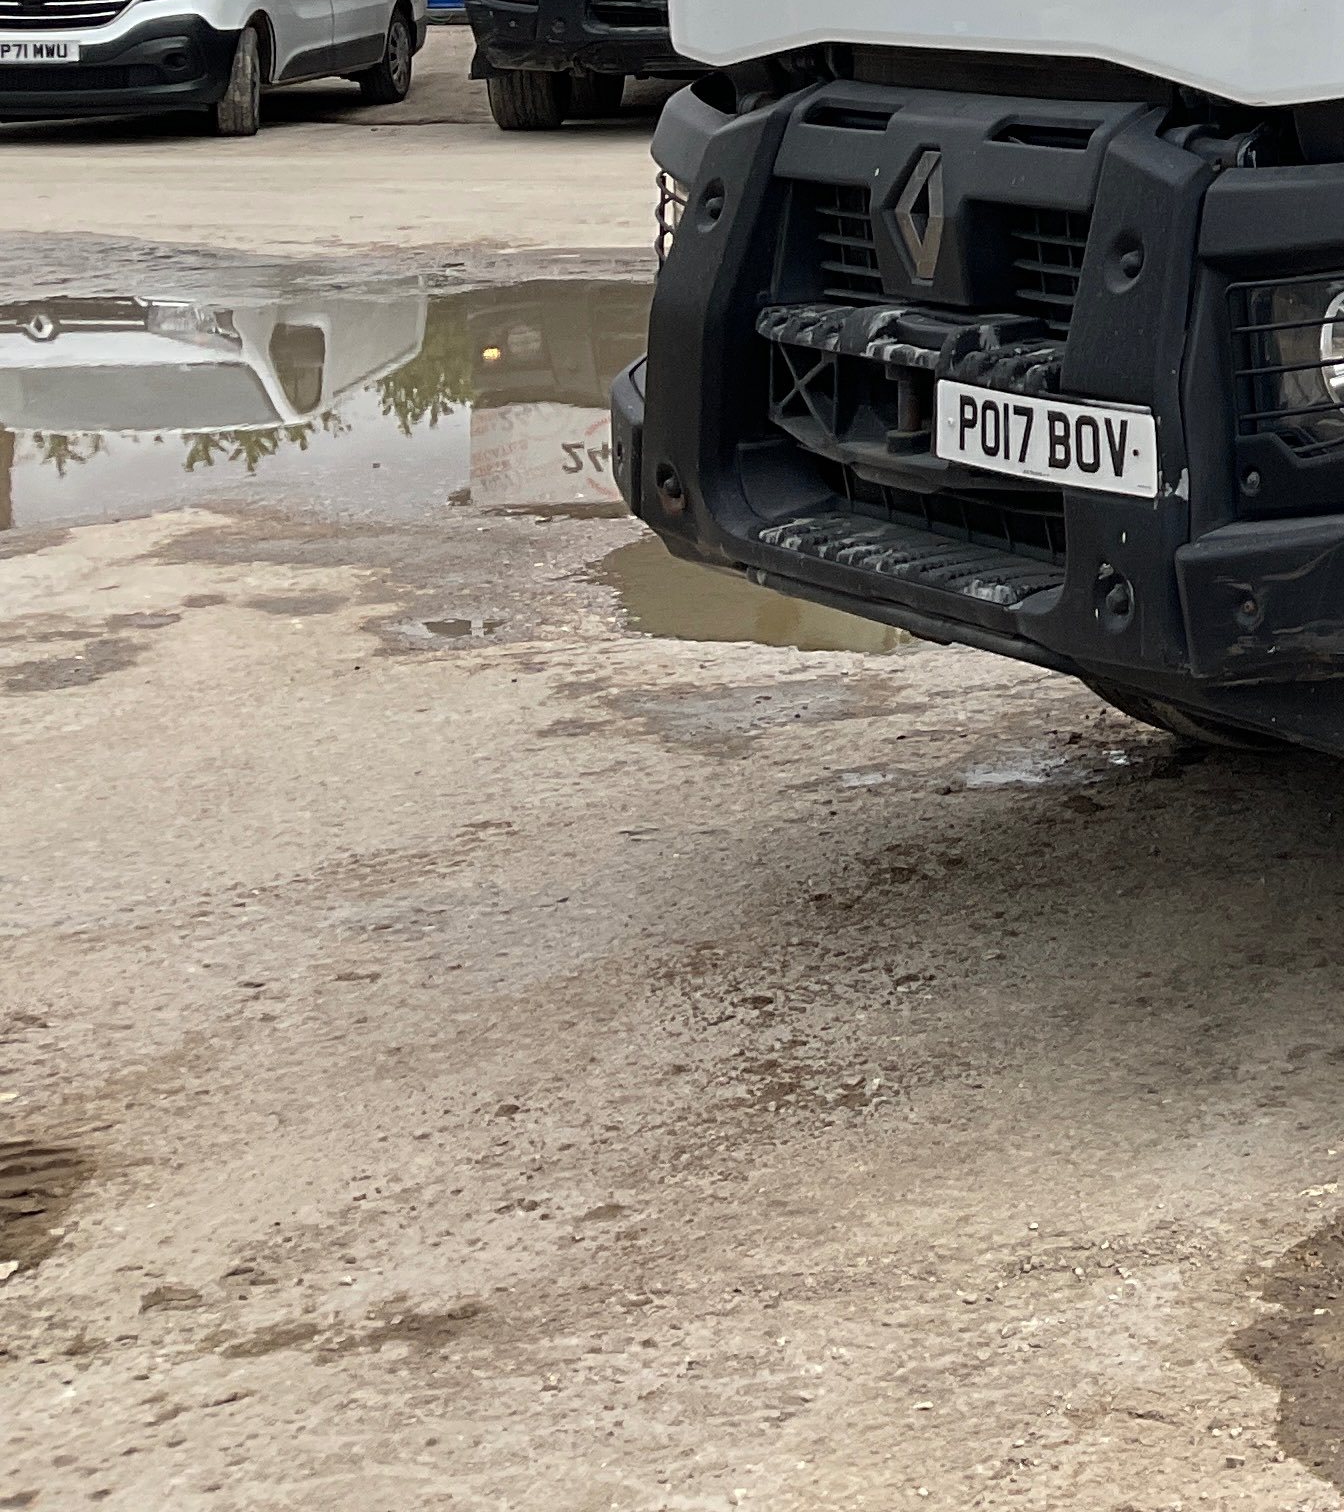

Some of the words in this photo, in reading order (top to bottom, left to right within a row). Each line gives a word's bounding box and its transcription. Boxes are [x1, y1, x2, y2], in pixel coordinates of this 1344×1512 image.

[33, 43, 68, 59] MWU
[959, 393, 1034, 463] PO17
[1047, 409, 1129, 478] BOV
